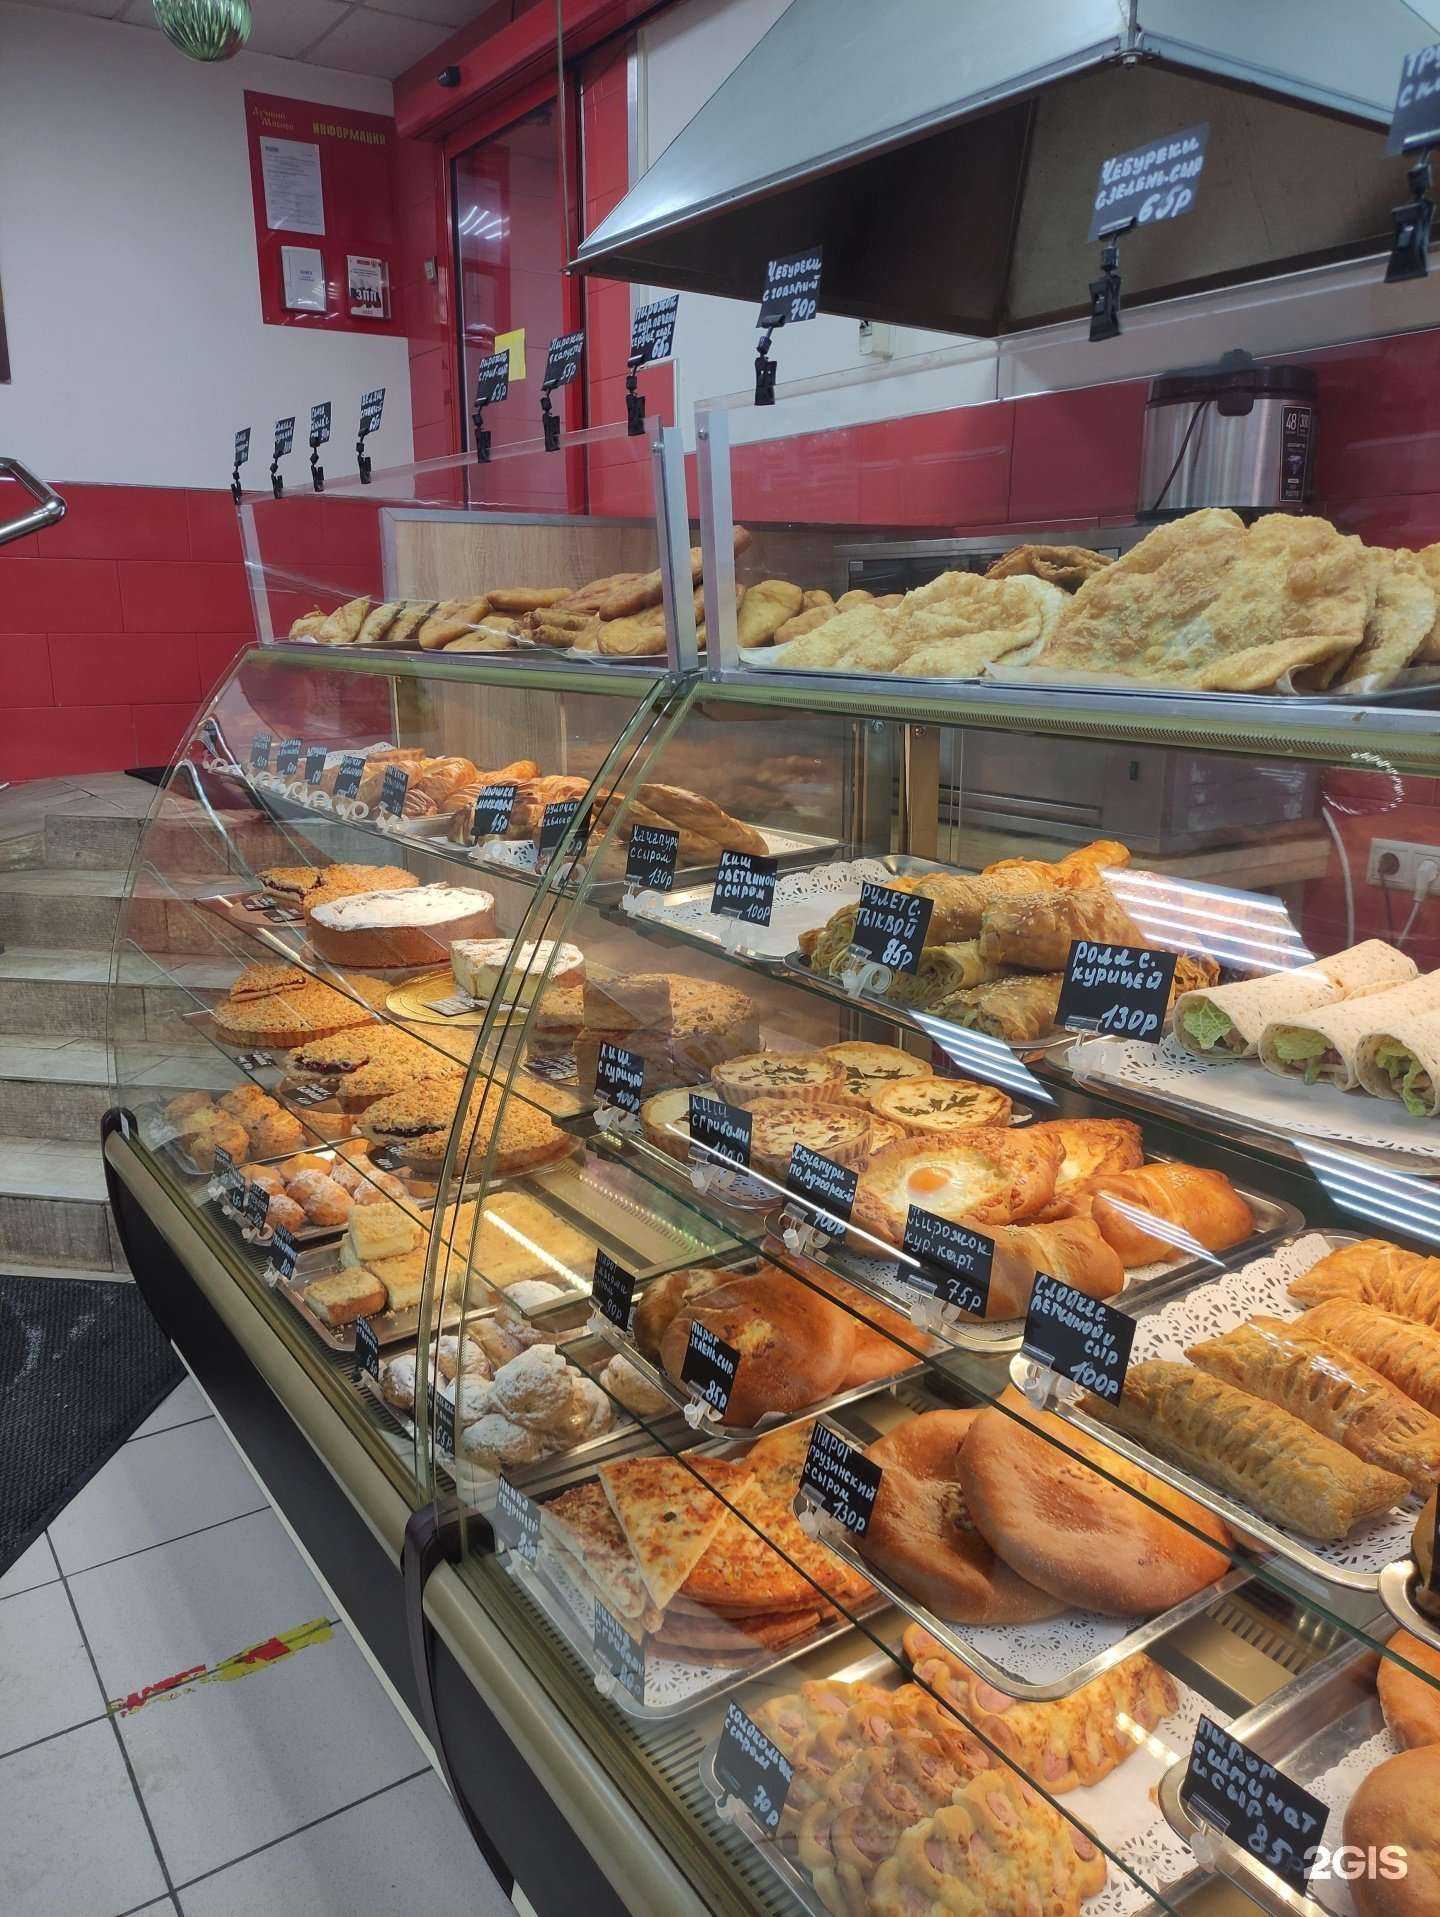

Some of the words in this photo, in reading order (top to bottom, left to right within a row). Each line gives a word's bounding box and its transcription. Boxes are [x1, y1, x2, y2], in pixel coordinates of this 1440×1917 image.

[312, 121, 386, 145] ИНФОРМАЦИЯ
[721, 853, 751, 868] Киш
[649, 866, 673, 889] 130р
[745, 903, 771, 920] 100р
[882, 938, 913, 970] 85р
[1101, 1003, 1158, 1036] 130р
[946, 1278, 982, 1312] 75р
[1069, 1360, 1120, 1398] 100р
[814, 1424, 853, 1463] Пирог
[832, 1501, 867, 1533] 130р
